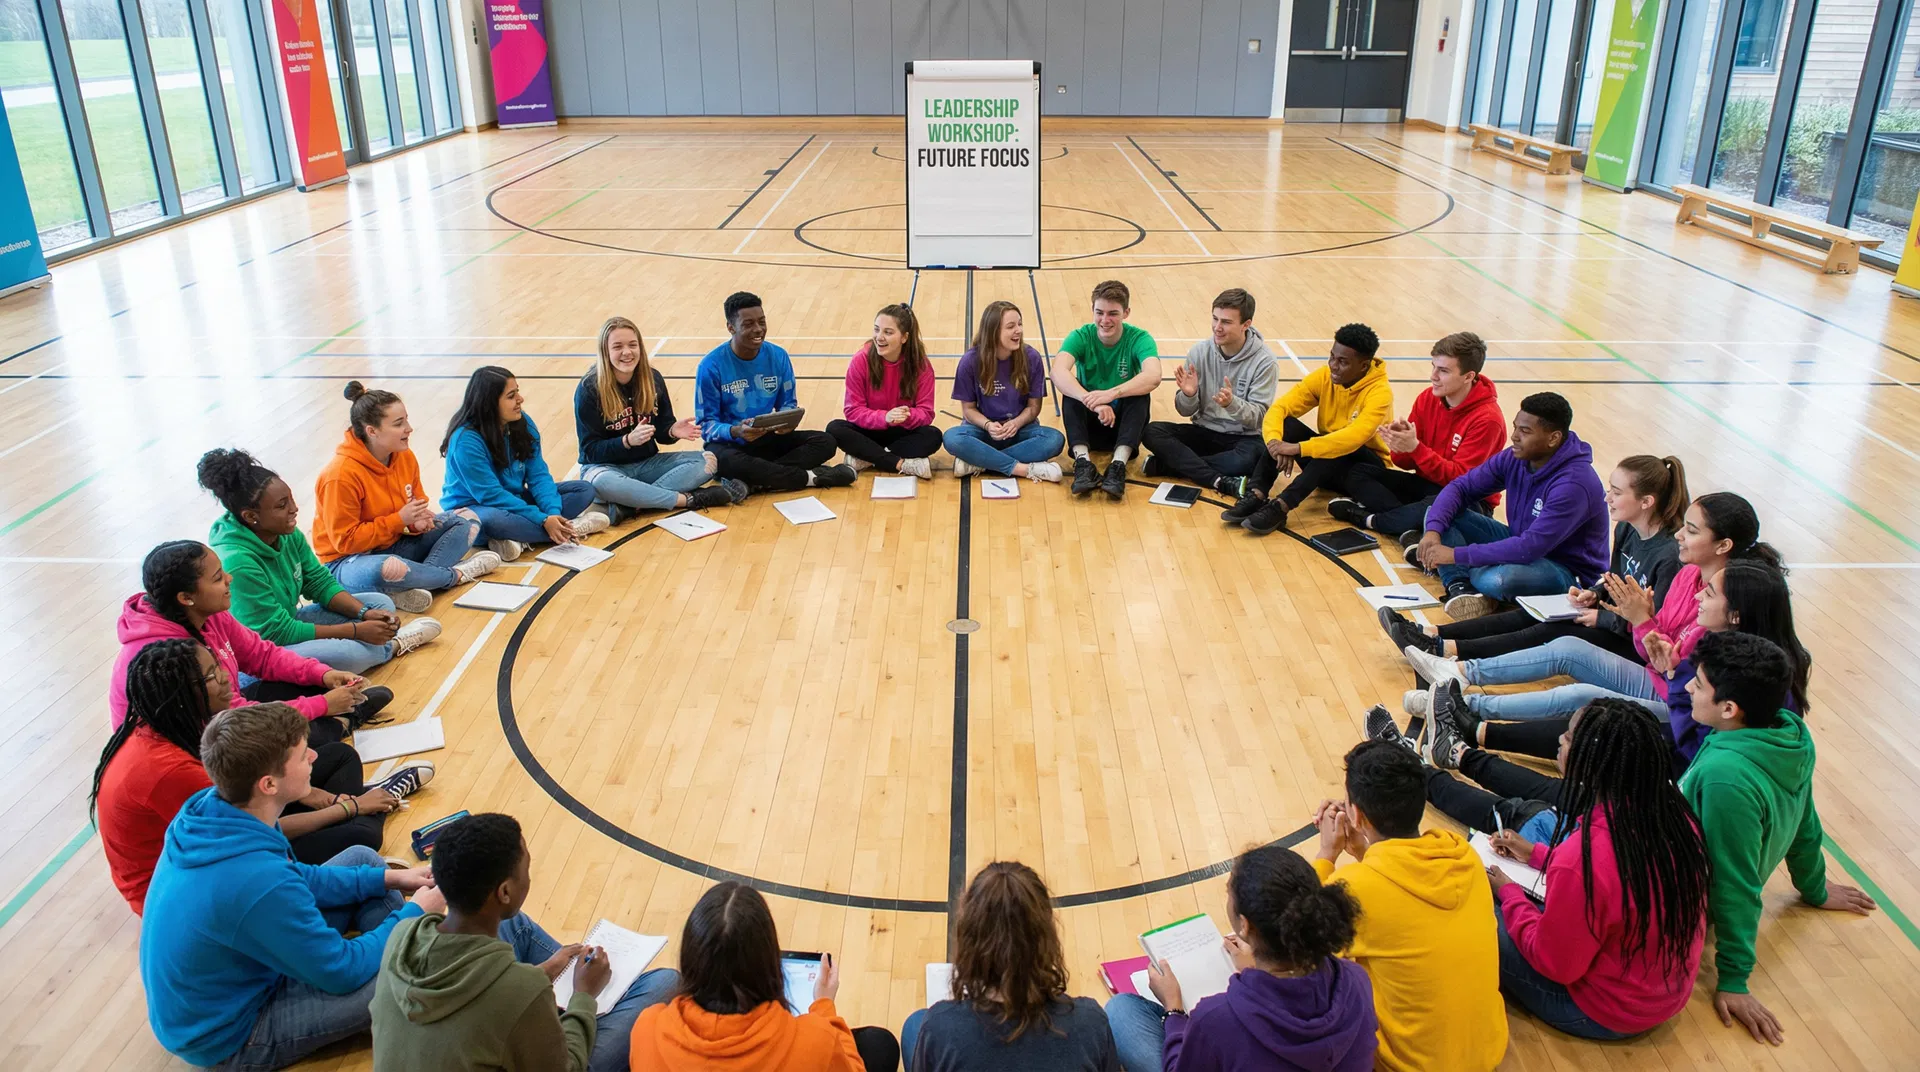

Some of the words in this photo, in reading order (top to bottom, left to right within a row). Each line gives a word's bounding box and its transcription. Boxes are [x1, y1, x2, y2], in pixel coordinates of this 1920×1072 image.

[924, 99, 1020, 118] LEADERSHIP
[927, 123, 1019, 143] WORKSHOP:
[918, 148, 977, 167] FUTURE
[981, 148, 1030, 168] FOCUS
